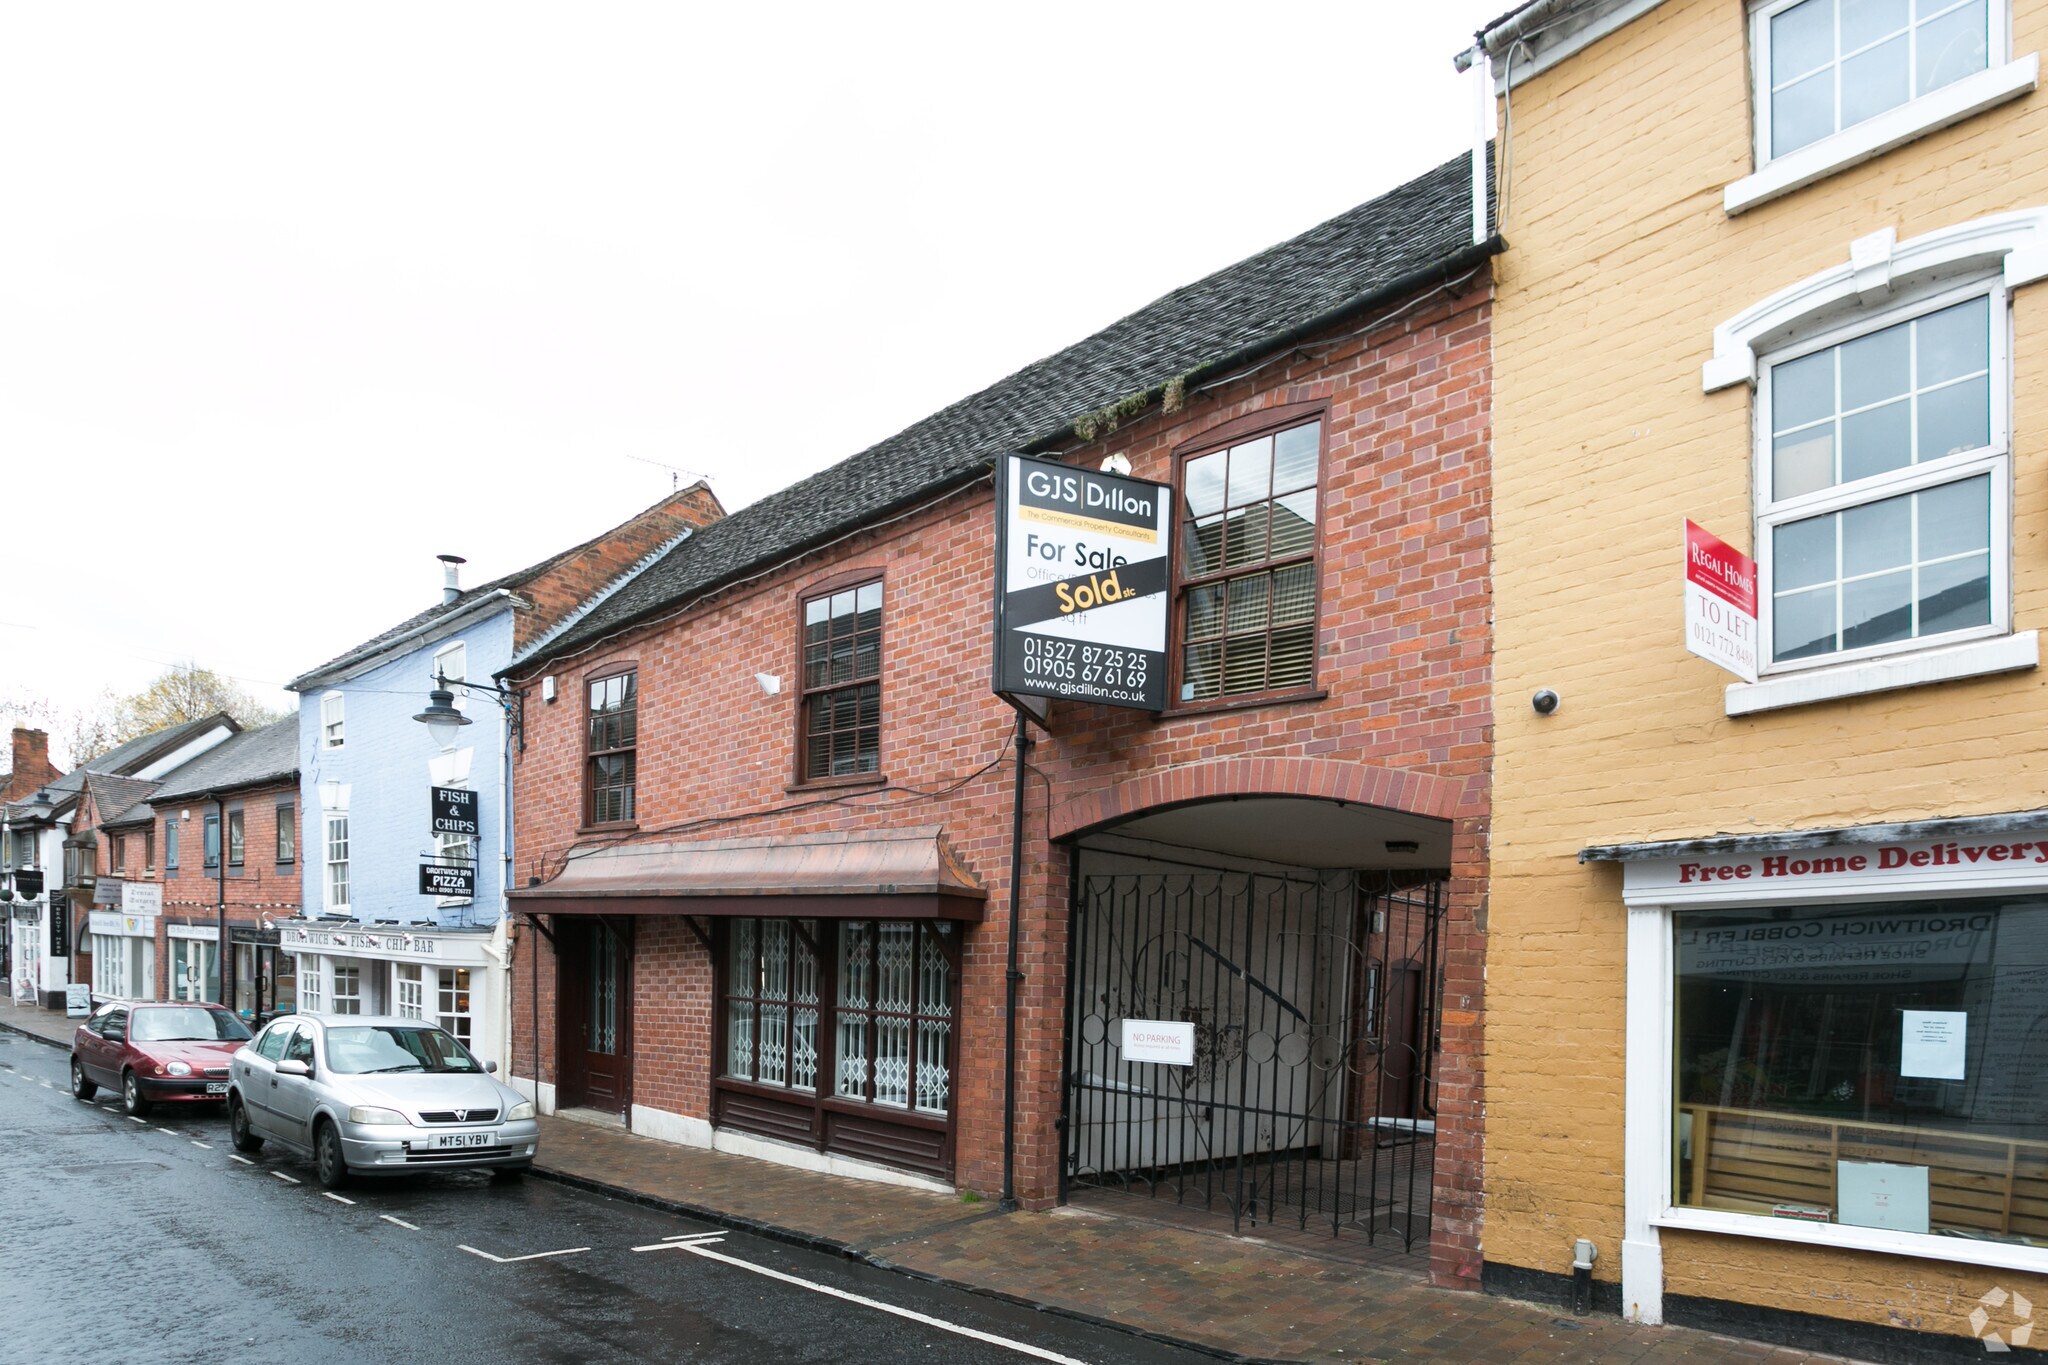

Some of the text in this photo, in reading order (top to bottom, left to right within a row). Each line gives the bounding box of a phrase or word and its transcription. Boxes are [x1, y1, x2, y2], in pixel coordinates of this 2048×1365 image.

[1027, 470, 1152, 518] GJS Dillon
[1027, 510, 1151, 541] The Commercial Property Consultants
[1027, 533, 1128, 570] For Sale
[1691, 542, 1723, 576] REGAL
[1724, 561, 1754, 596] HOMES
[1055, 570, 1137, 613] Sold stc
[1698, 594, 1750, 642] TO LET
[1694, 622, 1716, 648] 0121
[1024, 637, 1147, 672] 01527 87 25 25
[1023, 655, 1147, 689] 01905 67 61 69
[1023, 677, 1146, 703] www.gjsdillon.co.uk
[439, 790, 470, 805] FISH
[449, 805, 460, 817] &
[435, 817, 476, 833] CHIPS
[426, 866, 472, 878] DROITWICH SPA
[1678, 839, 2048, 884] Free Home Delivery
[433, 875, 466, 888] PIZZA
[351, 935, 373, 948] FISH
[414, 940, 434, 953] BAR
[1132, 1033, 1181, 1045] NO PARKING
[468, 1134, 489, 1146] YBV
